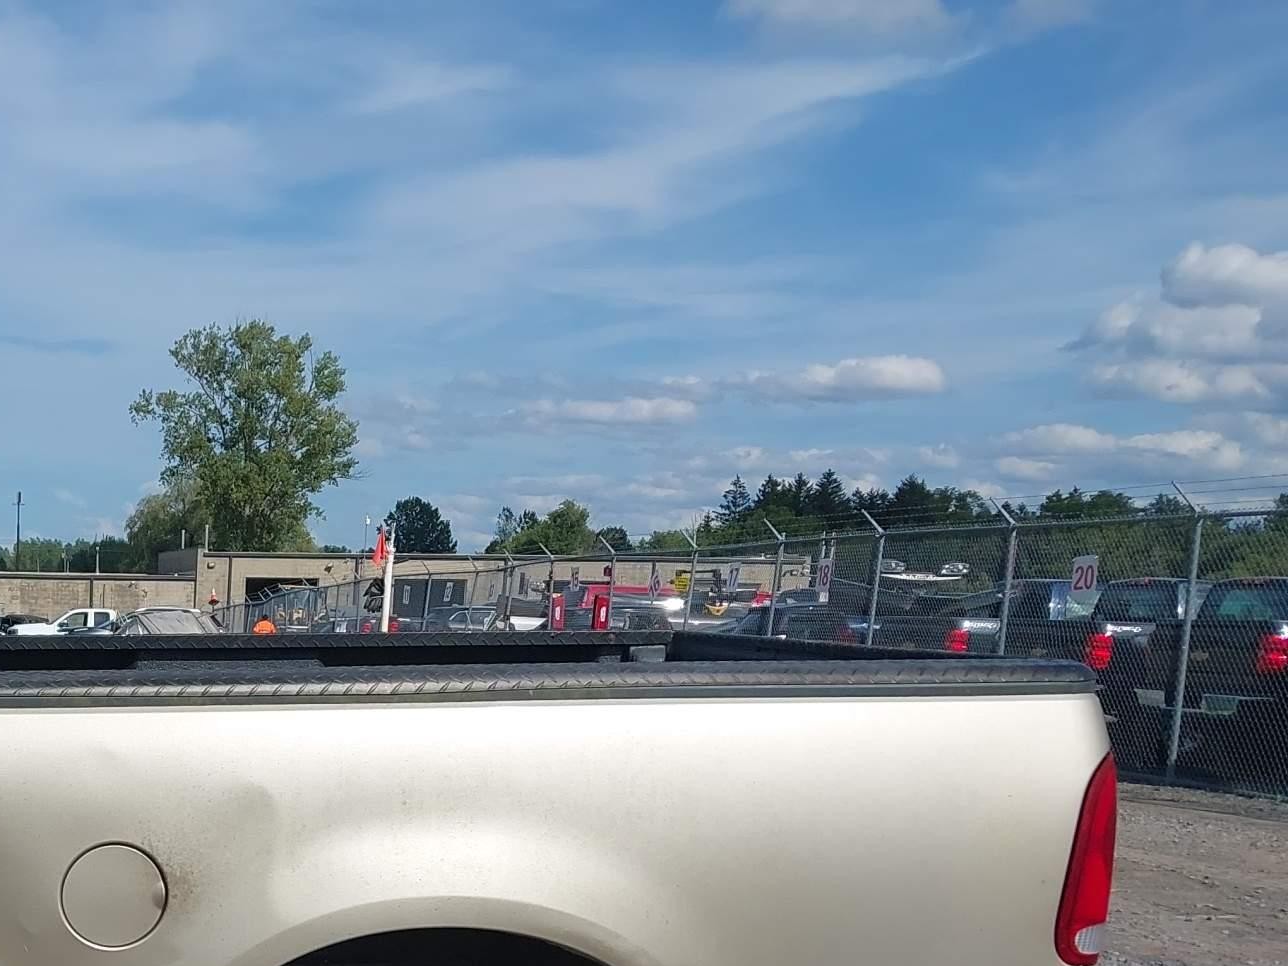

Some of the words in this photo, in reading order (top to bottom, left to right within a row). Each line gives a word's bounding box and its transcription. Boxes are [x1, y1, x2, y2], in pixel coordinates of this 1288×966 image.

[728, 568, 739, 588] 17
[818, 564, 830, 586] 18
[1073, 564, 1095, 591] 20
